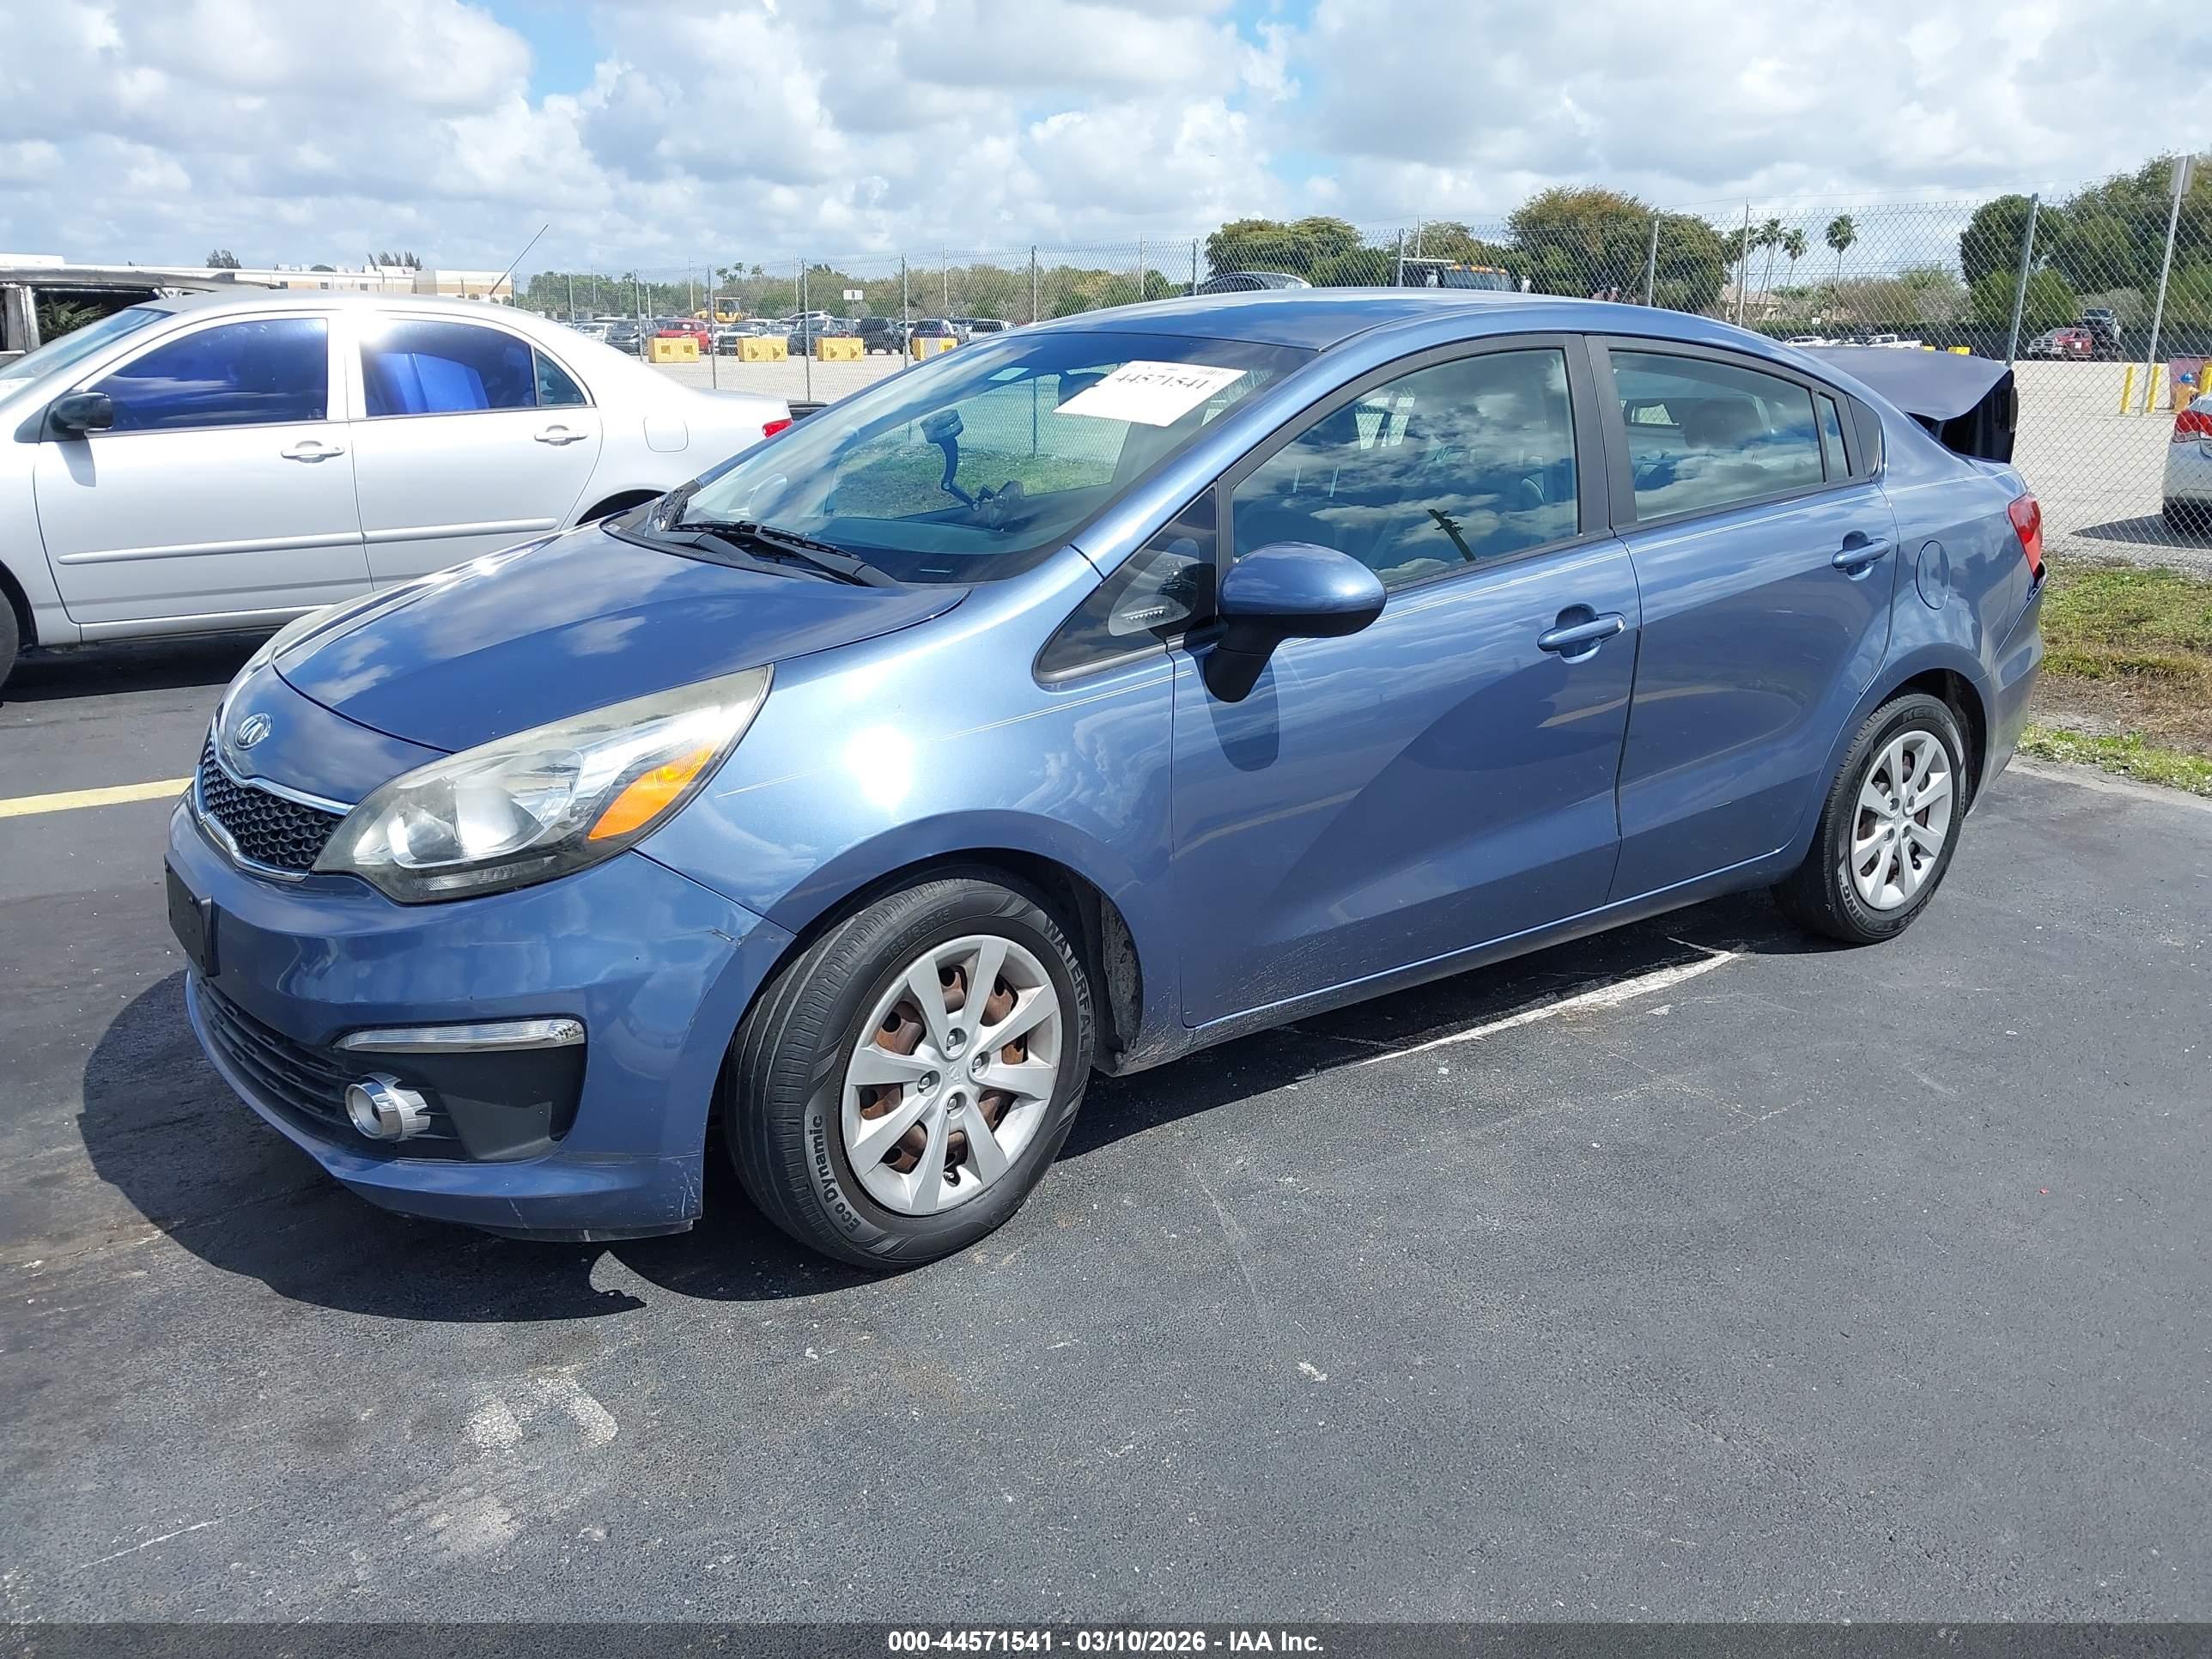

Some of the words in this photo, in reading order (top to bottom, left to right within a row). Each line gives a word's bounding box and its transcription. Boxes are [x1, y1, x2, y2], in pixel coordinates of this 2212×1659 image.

[1043, 915, 1092, 1066] WATERFALL
[809, 1114, 840, 1205] Dynamic
[834, 1201, 862, 1234] Eco
